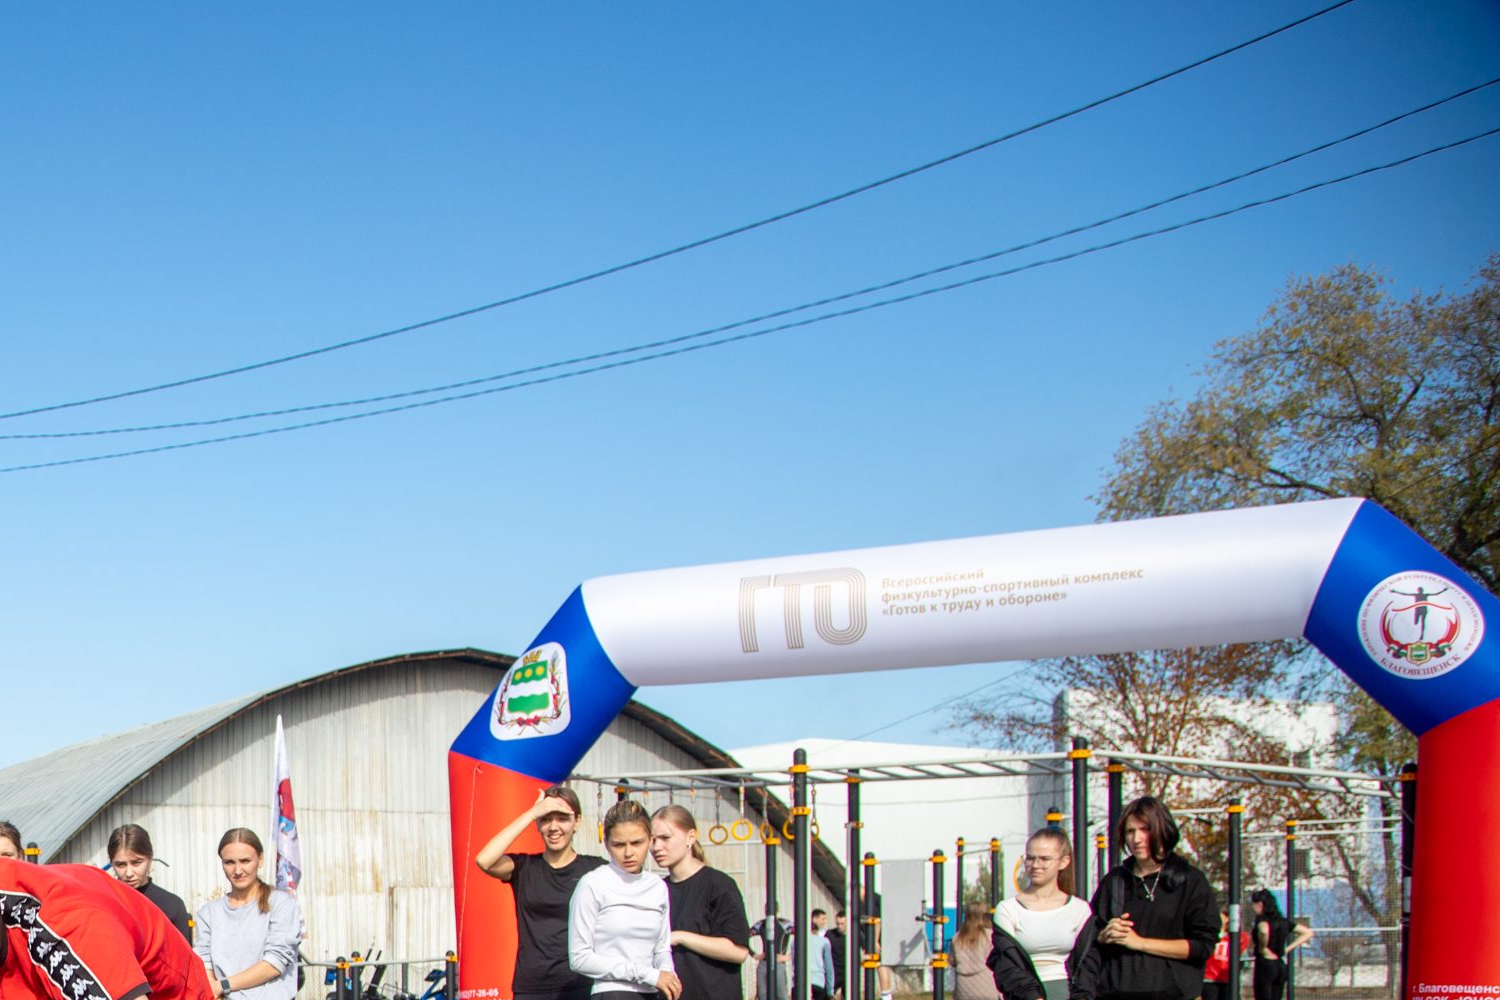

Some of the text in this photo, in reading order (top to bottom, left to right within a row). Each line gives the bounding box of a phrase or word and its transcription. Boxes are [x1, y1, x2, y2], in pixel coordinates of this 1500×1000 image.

[881, 569, 1144, 604] физкультурно-спортивный комплекс
[882, 569, 984, 588] Всероссийский
[739, 567, 867, 653] ГТО
[882, 592, 1067, 616] «Готов к труду и обороне»
[1380, 653, 1462, 676] БЛАГОВЕЩЕНСК
